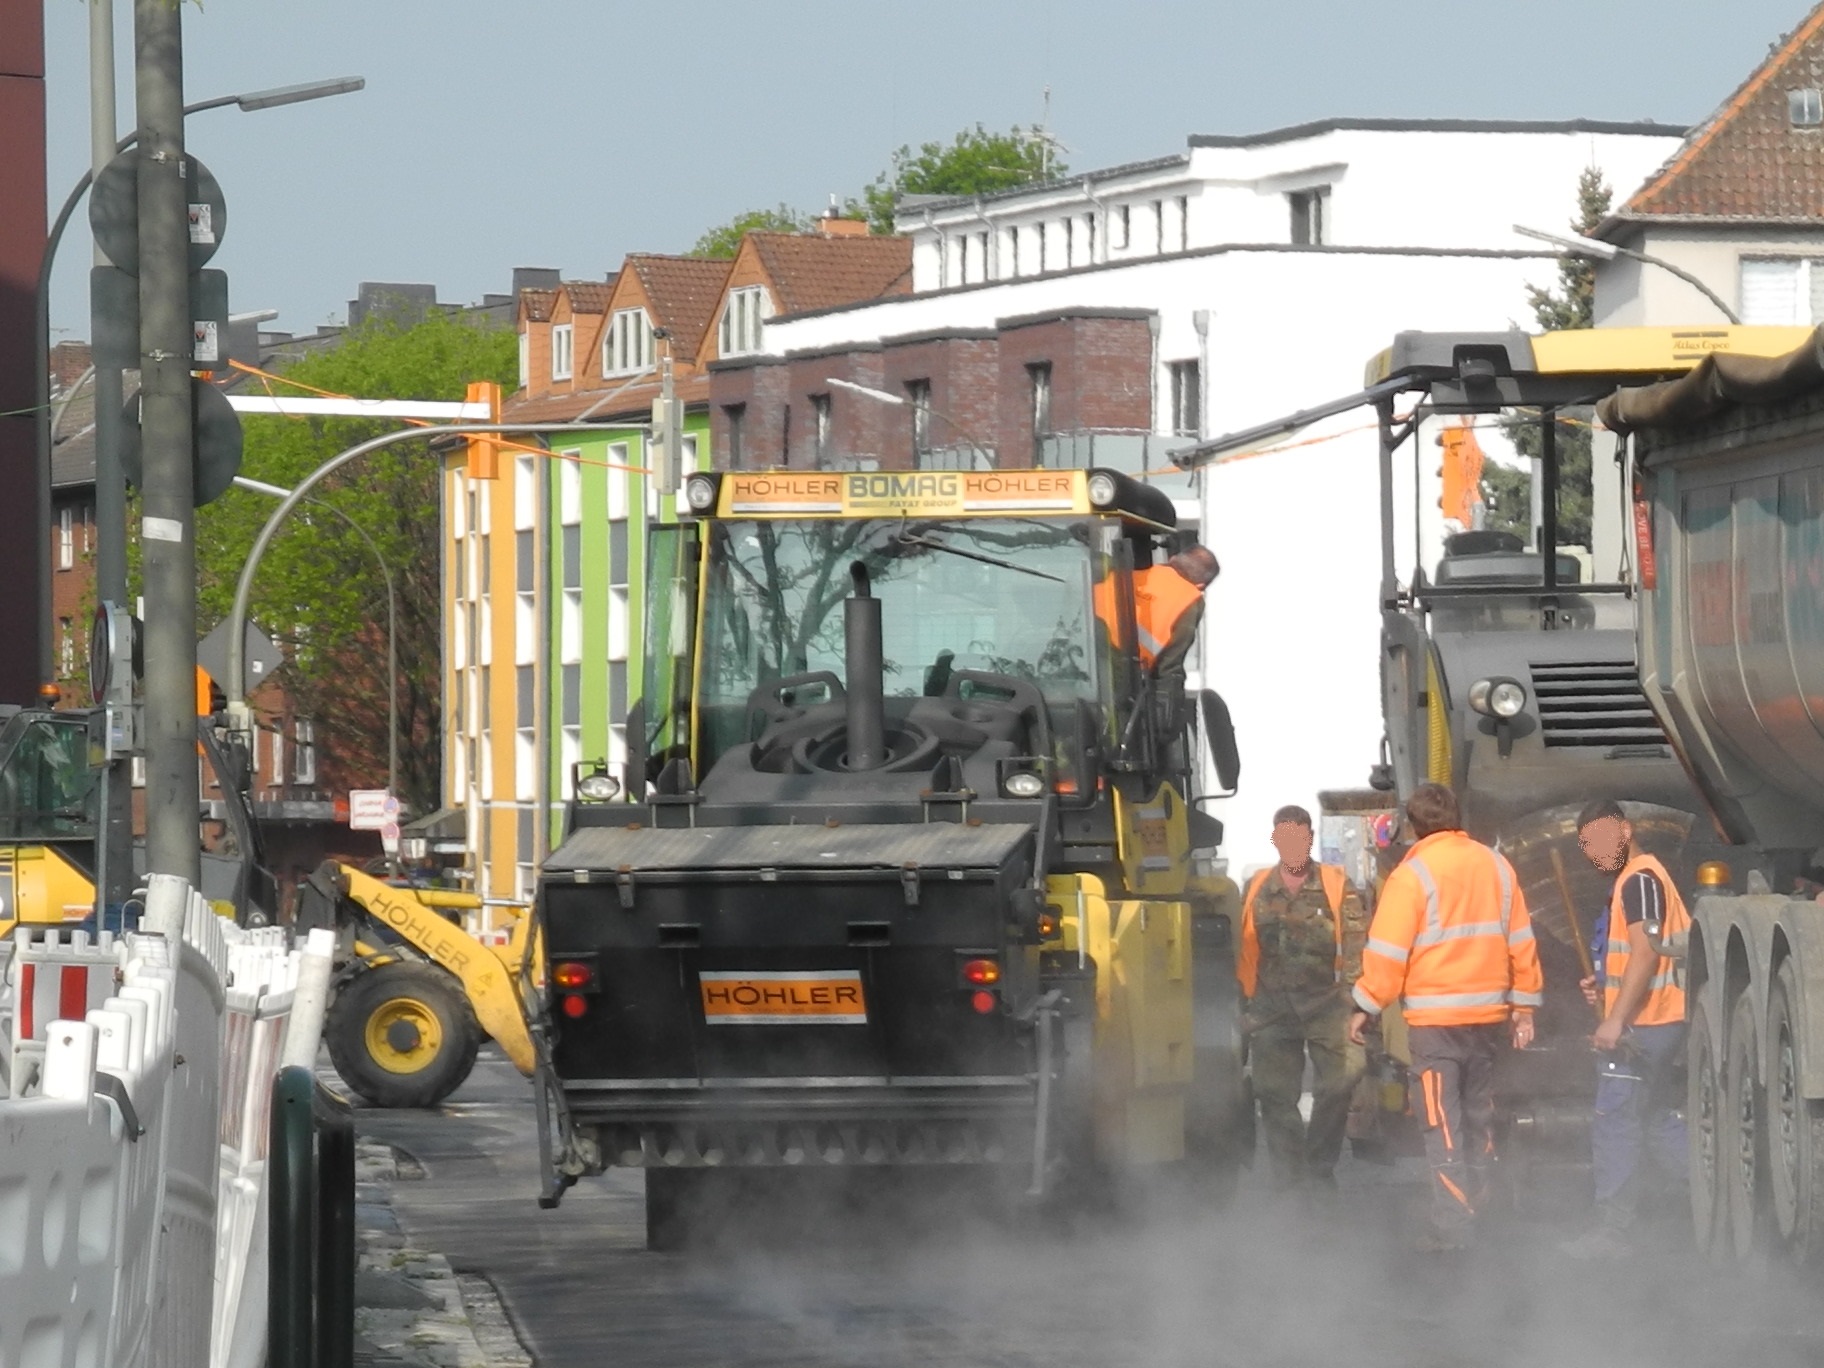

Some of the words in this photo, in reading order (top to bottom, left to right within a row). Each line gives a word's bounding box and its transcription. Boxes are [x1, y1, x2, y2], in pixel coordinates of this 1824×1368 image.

[735, 475, 839, 495] HÖHLER
[849, 475, 957, 498] BOMAG
[966, 473, 1069, 493] HÖHLER
[706, 981, 858, 1005] HÖHLER
